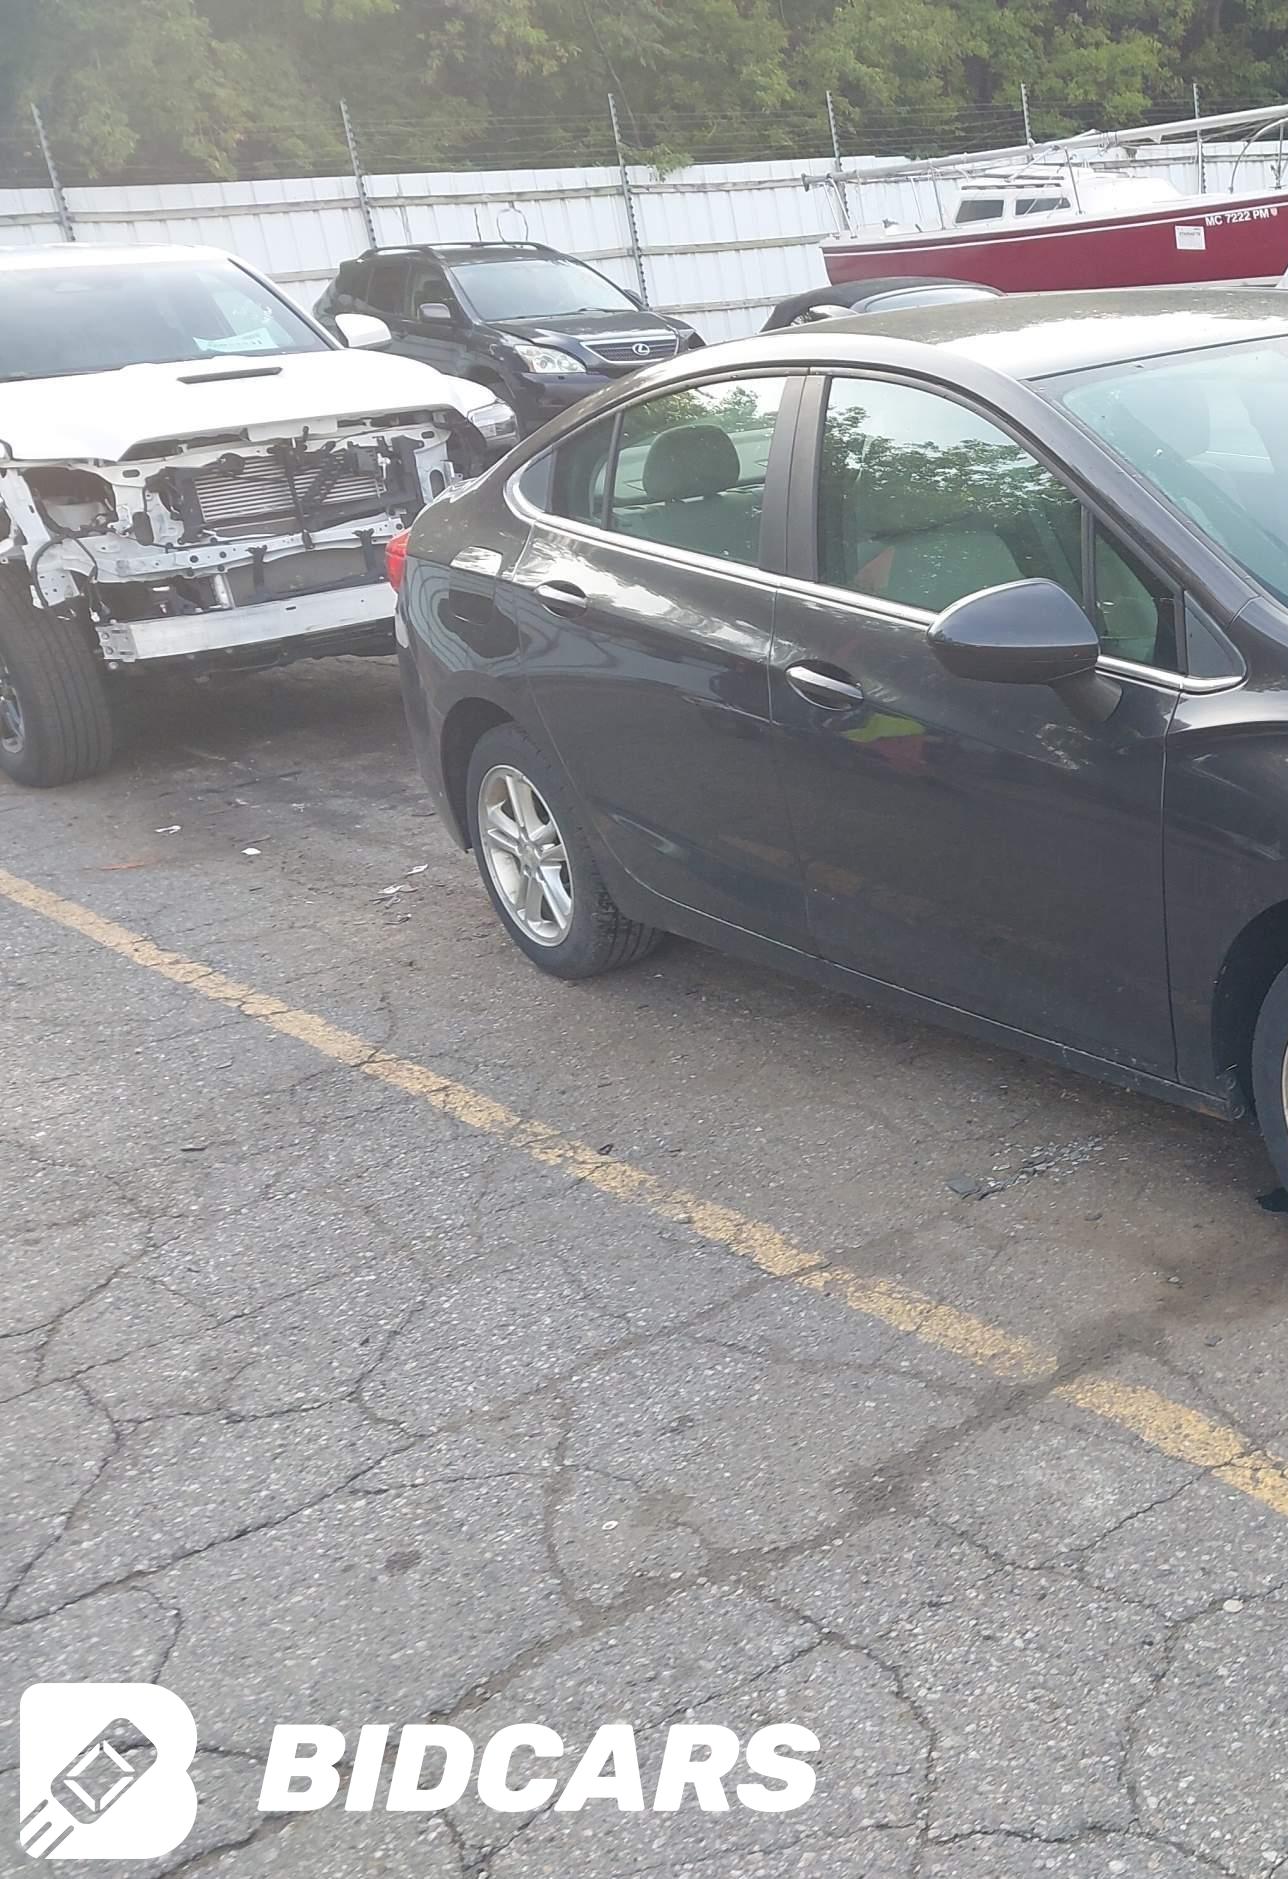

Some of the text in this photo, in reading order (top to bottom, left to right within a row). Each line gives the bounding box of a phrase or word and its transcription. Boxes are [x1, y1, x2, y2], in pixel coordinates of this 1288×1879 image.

[1205, 208, 1270, 226] MC 7222 PM
